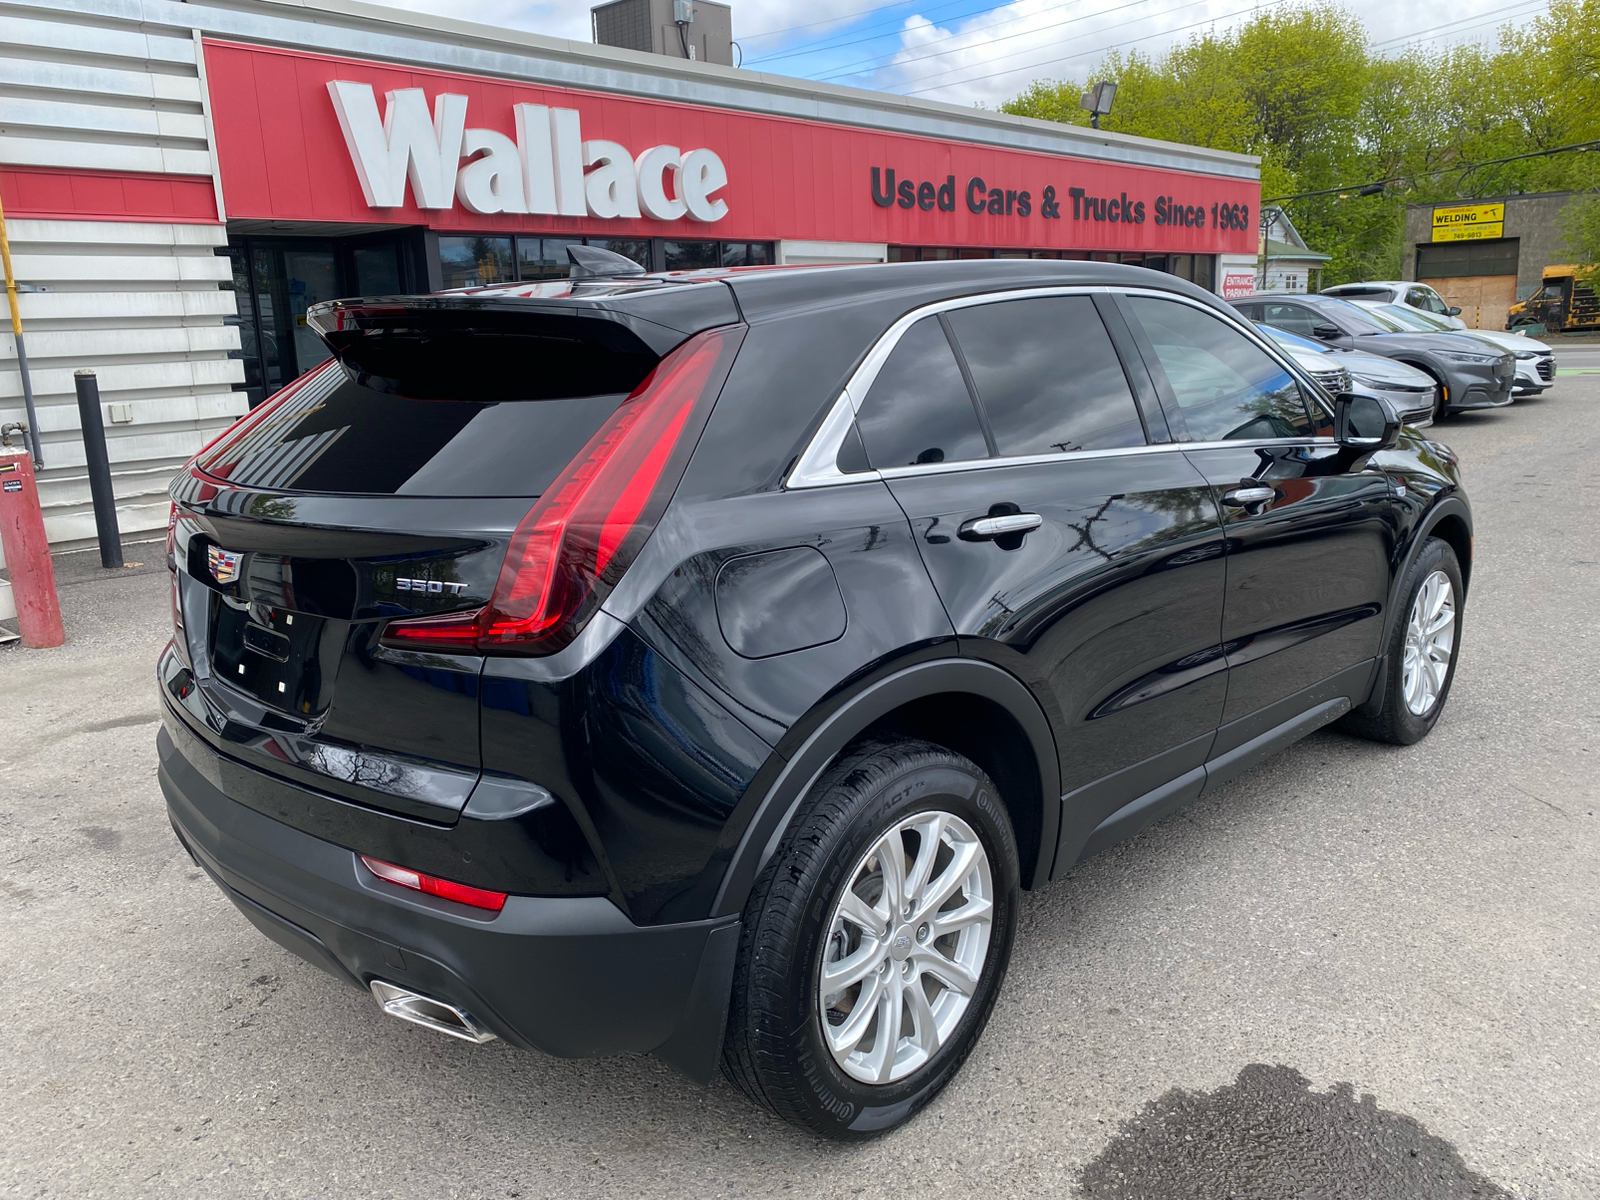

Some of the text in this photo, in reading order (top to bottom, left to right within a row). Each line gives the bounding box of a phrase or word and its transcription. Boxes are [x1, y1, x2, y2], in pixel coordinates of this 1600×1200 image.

[327, 80, 729, 222] Wallace
[871, 166, 1249, 231] Used Cars & Trucks Since 1963
[1436, 213, 1477, 223] WELDING
[1226, 276, 1253, 286] ENTRANCE
[1226, 288, 1253, 298] PARKING
[797, 1049, 855, 1123] Continental
